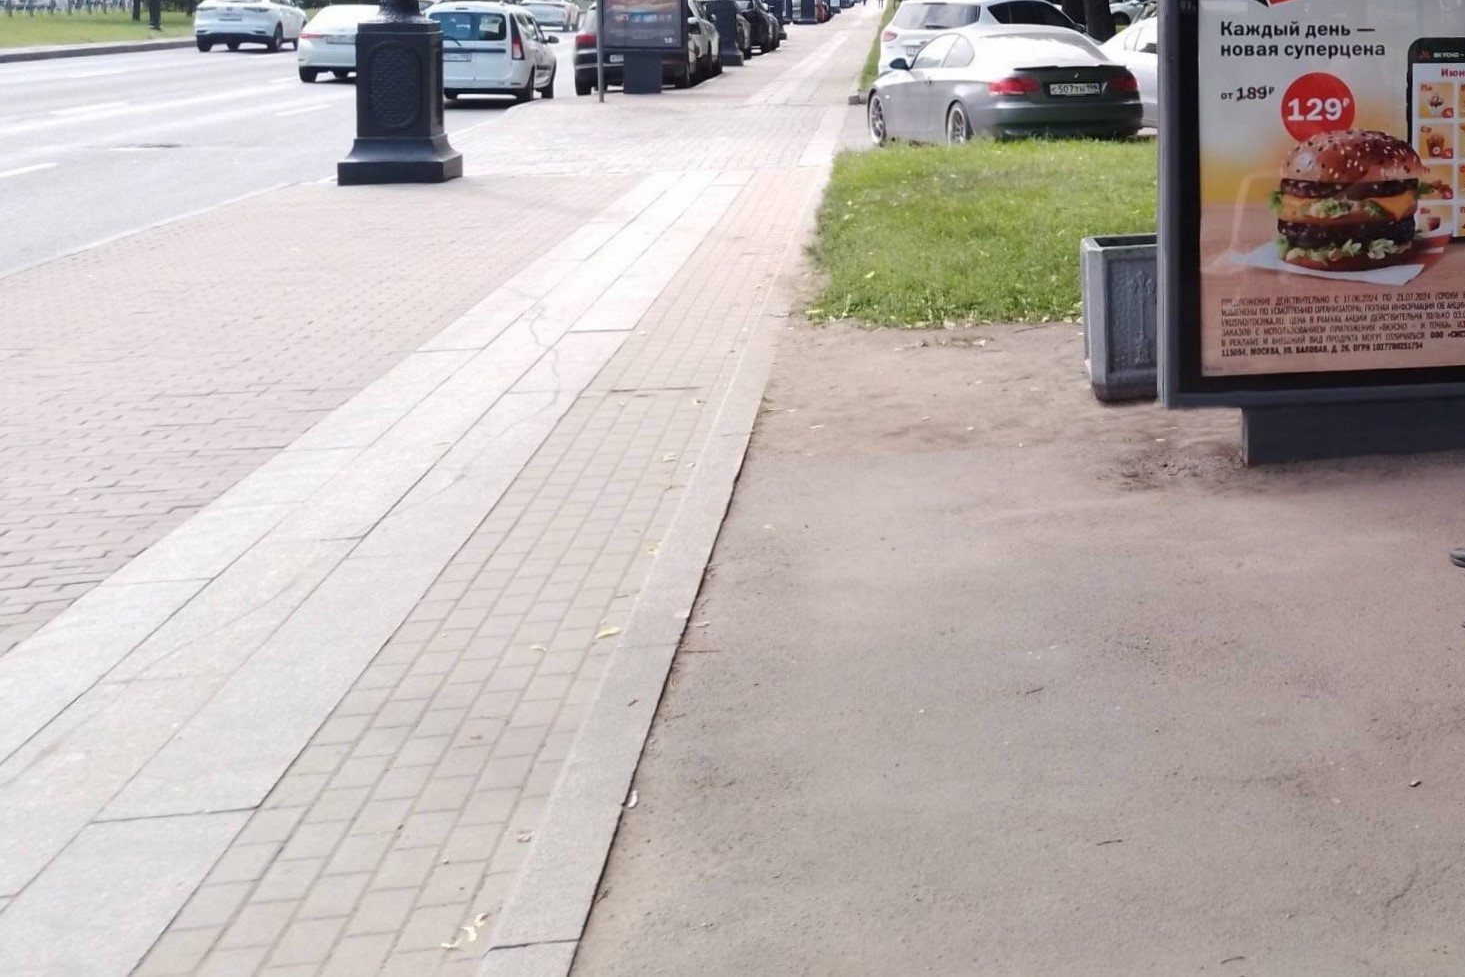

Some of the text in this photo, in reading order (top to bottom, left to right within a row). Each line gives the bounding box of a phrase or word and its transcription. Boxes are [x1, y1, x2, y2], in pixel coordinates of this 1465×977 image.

[1220, 20, 1301, 37] Каждый
[1304, 25, 1352, 38] день
[1220, 43, 1386, 60] новая суперцена
[1220, 91, 1234, 100] от
